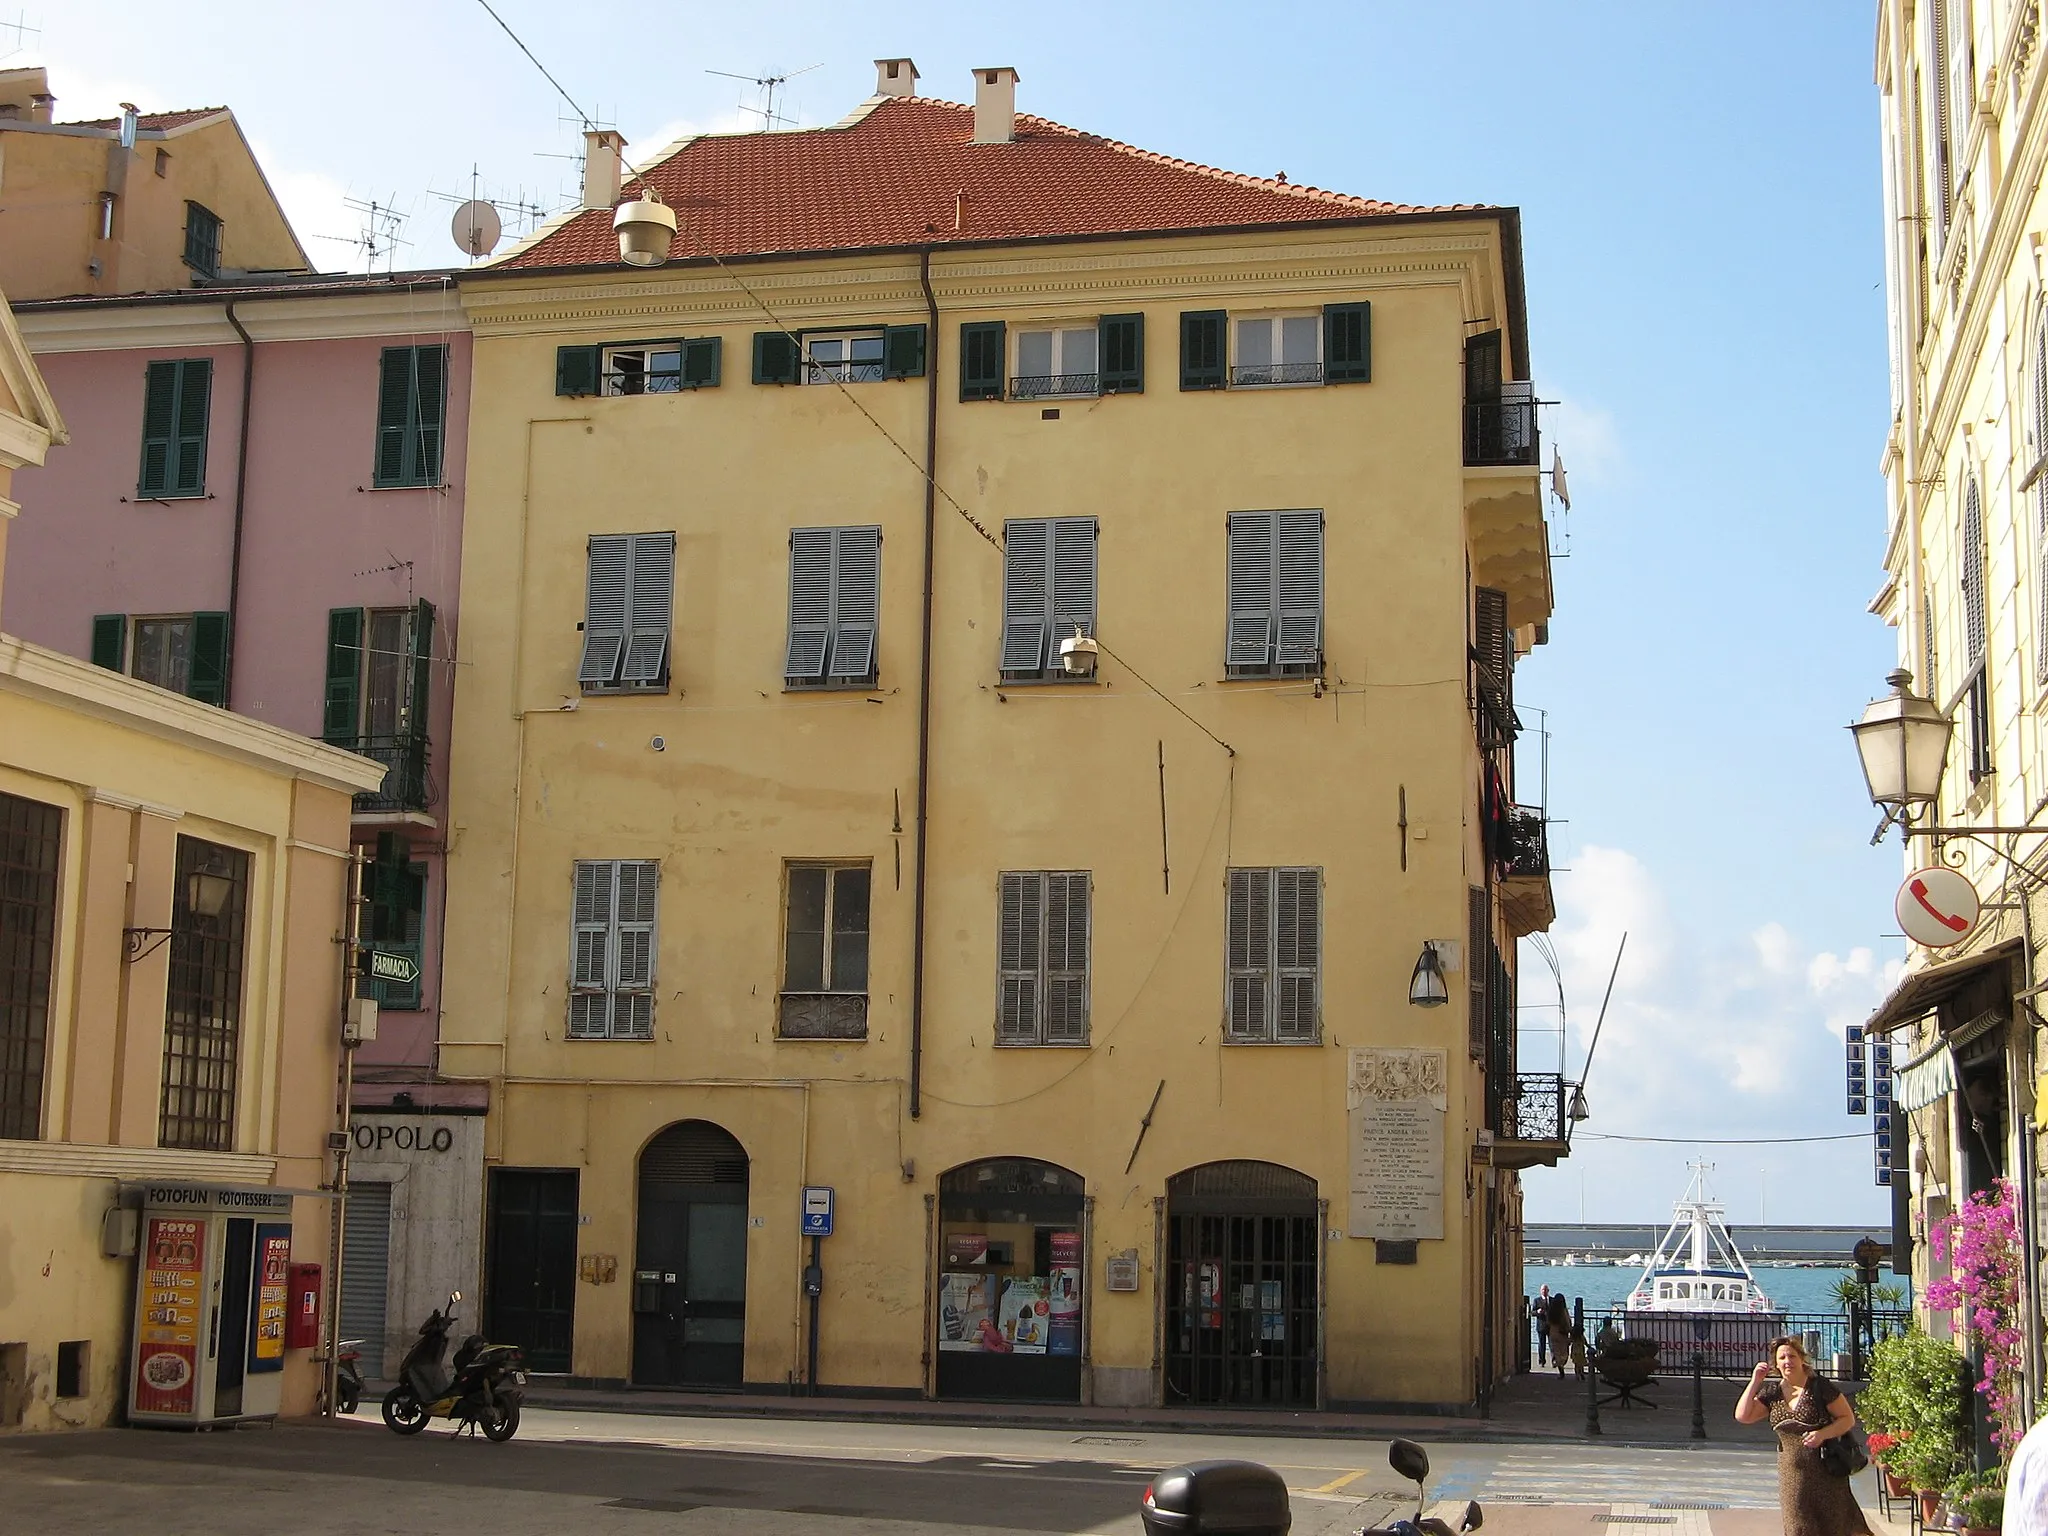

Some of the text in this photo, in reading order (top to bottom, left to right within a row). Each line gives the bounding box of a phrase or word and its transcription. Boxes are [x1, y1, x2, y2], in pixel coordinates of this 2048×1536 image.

[373, 955, 410, 979] FARMACIA
[1849, 1028, 1864, 1113] NIZZA
[1877, 1031, 1891, 1183] ISTORANTE
[150, 1188, 208, 1204] FOTOFUN
[218, 1191, 272, 1207] FOTOTESSERE
[158, 1222, 197, 1233] FOTO
[1657, 1341, 1683, 1351] OLO
[1685, 1341, 1731, 1352] TENNIS
